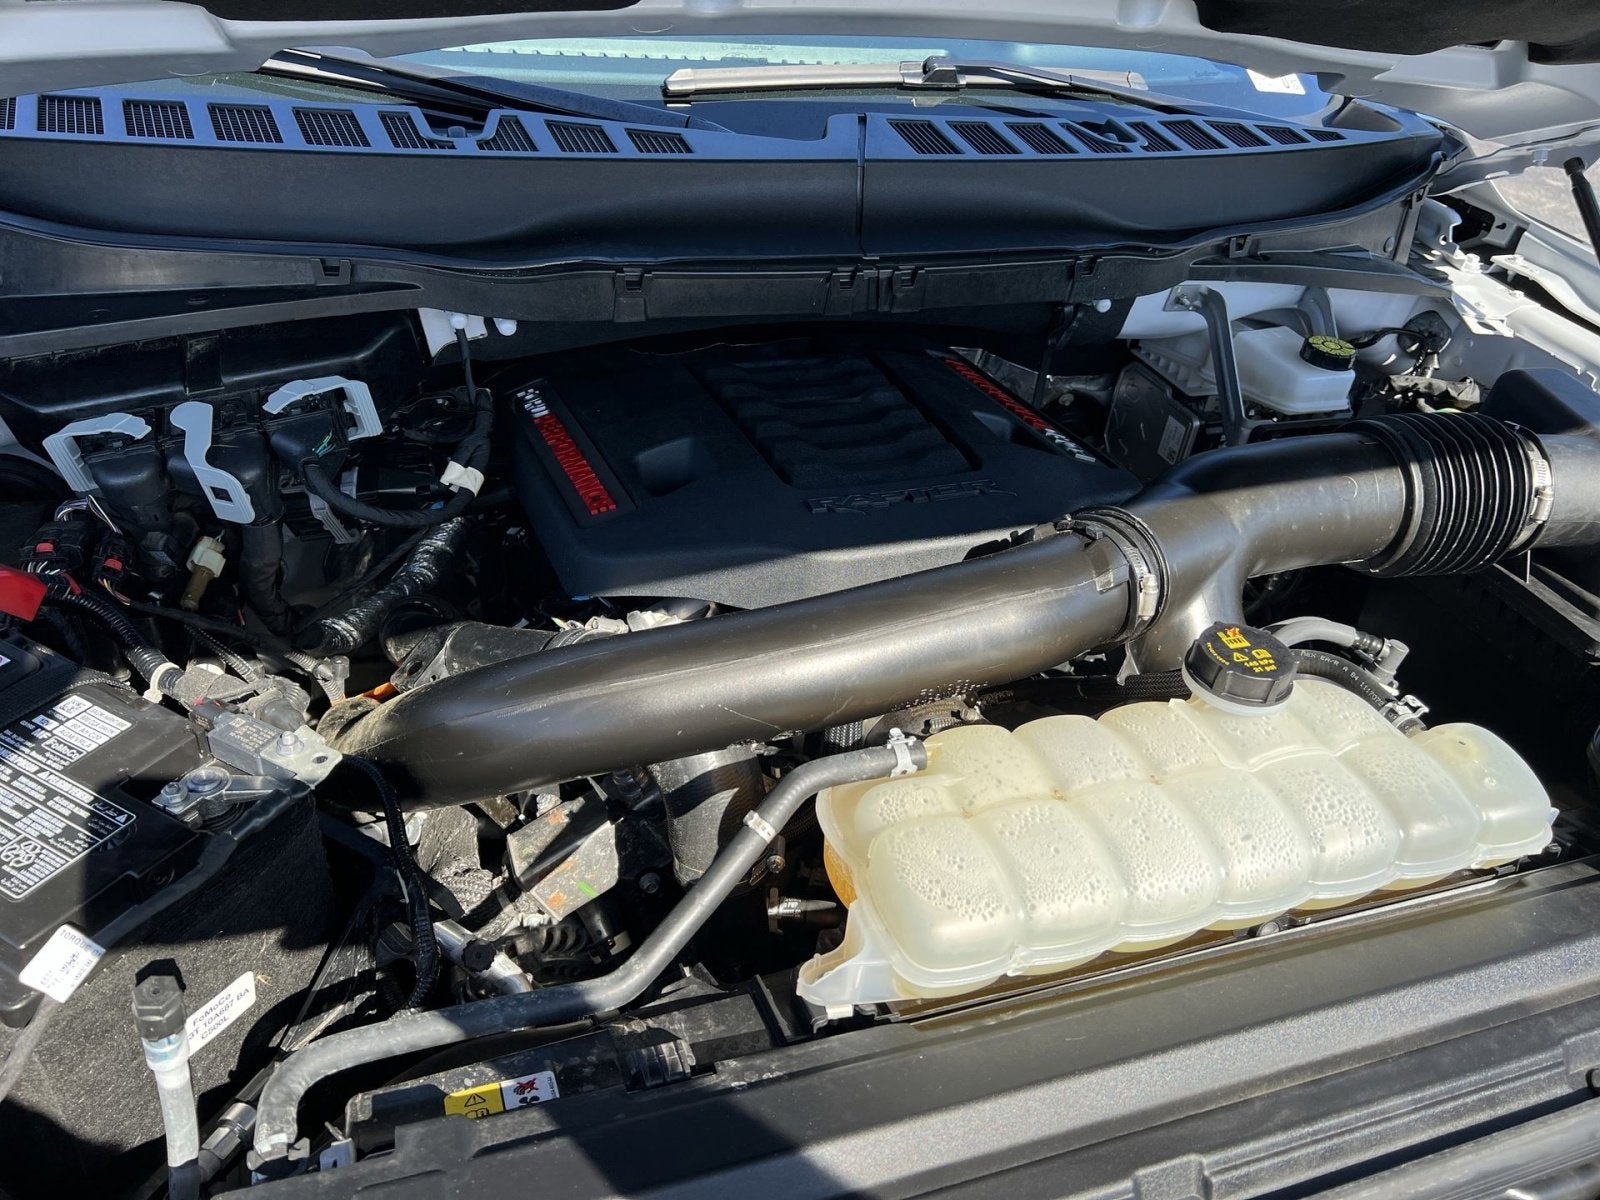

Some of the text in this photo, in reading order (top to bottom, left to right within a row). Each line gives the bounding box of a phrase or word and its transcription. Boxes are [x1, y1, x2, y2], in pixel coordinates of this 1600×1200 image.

[533, 412, 617, 516] PERFORMANCE
[802, 478, 1018, 516] RAPTOR
[47, 738, 81, 760] FoMoCo
[60, 929, 91, 953] TORQUE
[236, 988, 250, 1001] BA
[193, 993, 231, 1027] FoMoCo
